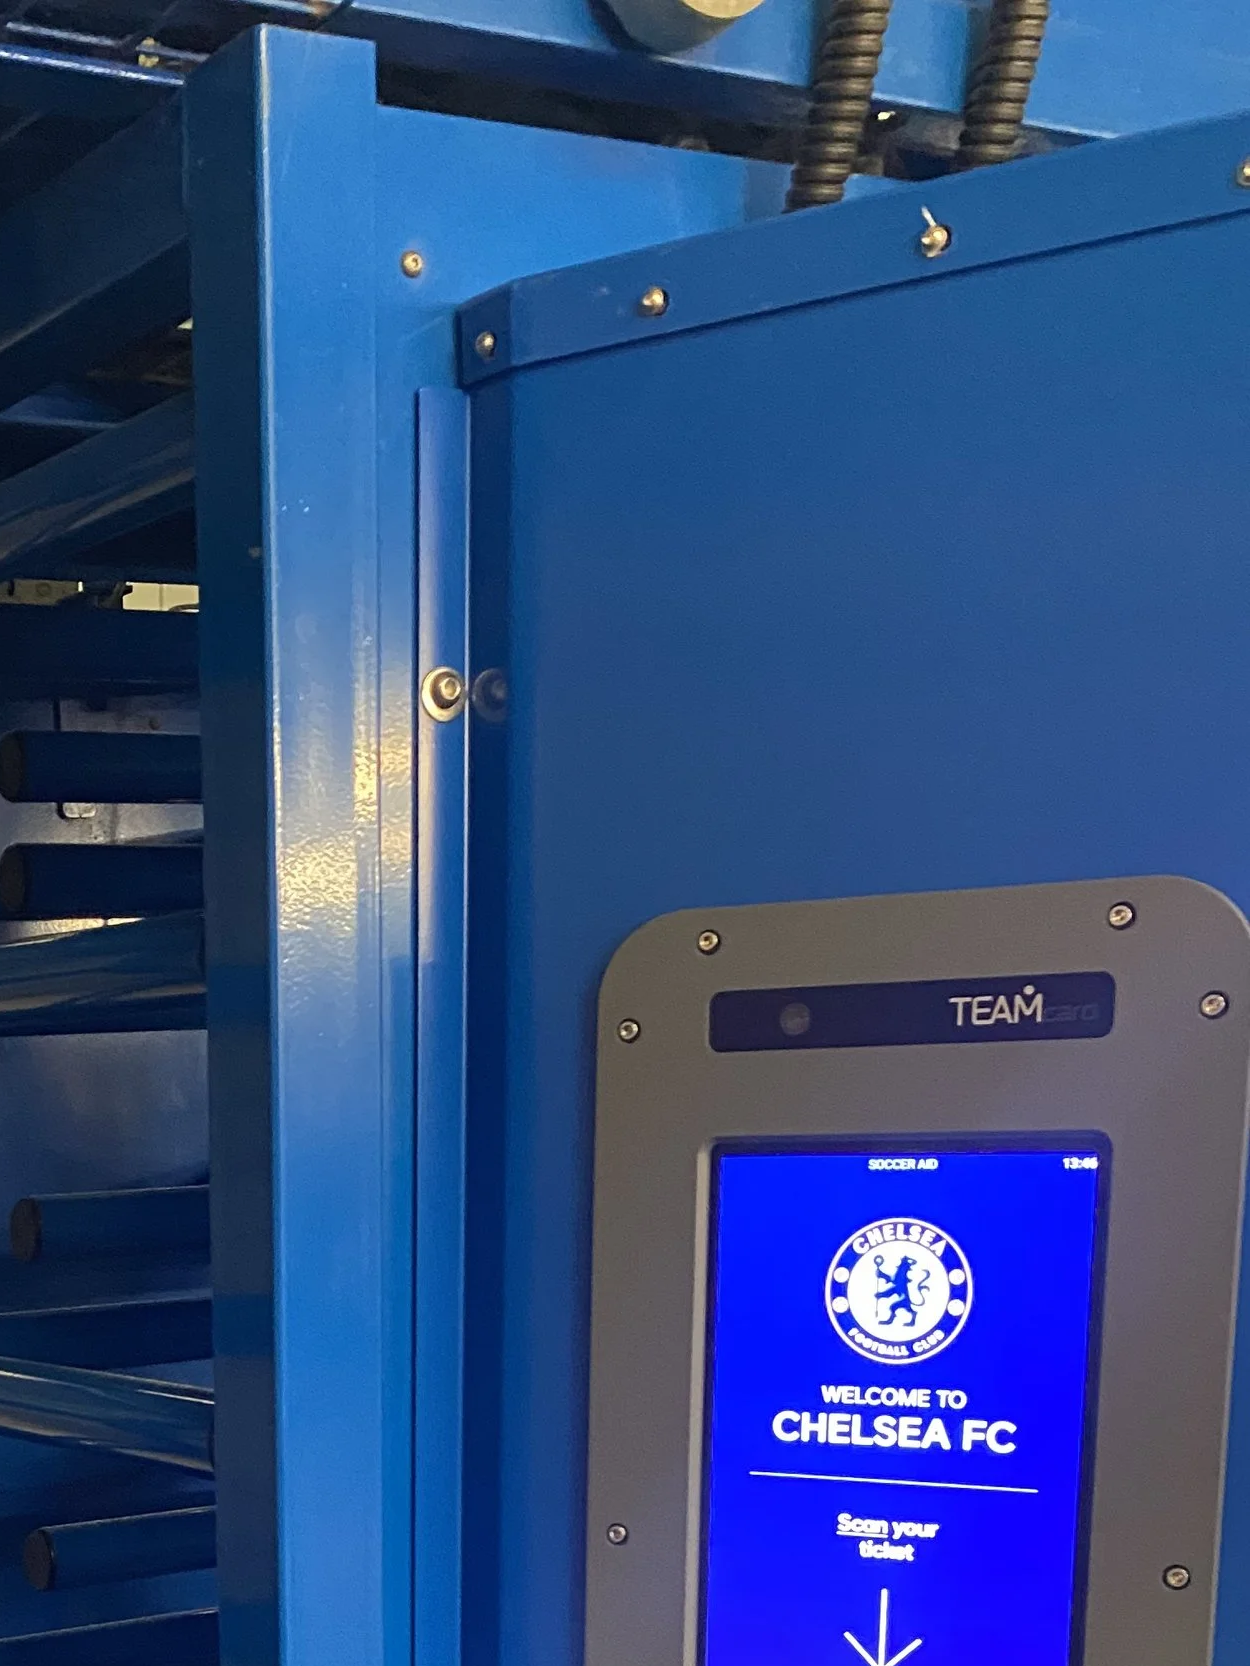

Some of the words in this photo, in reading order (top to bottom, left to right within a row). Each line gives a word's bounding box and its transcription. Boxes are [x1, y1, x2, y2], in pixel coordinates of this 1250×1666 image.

[867, 1158, 916, 1171] SOCCER
[916, 1158, 939, 1170] AID
[852, 1223, 947, 1257] CHELSEA
[847, 1327, 910, 1357] FOOTBALL
[912, 1329, 945, 1353] CLUB
[820, 1384, 932, 1408] WELCOME
[935, 1389, 968, 1410] TO
[772, 1410, 952, 1451] CHELSEA
[961, 1419, 1018, 1454] FC
[837, 1512, 889, 1535] Scan
[891, 1521, 940, 1540] your
[858, 1539, 915, 1562] ticket
